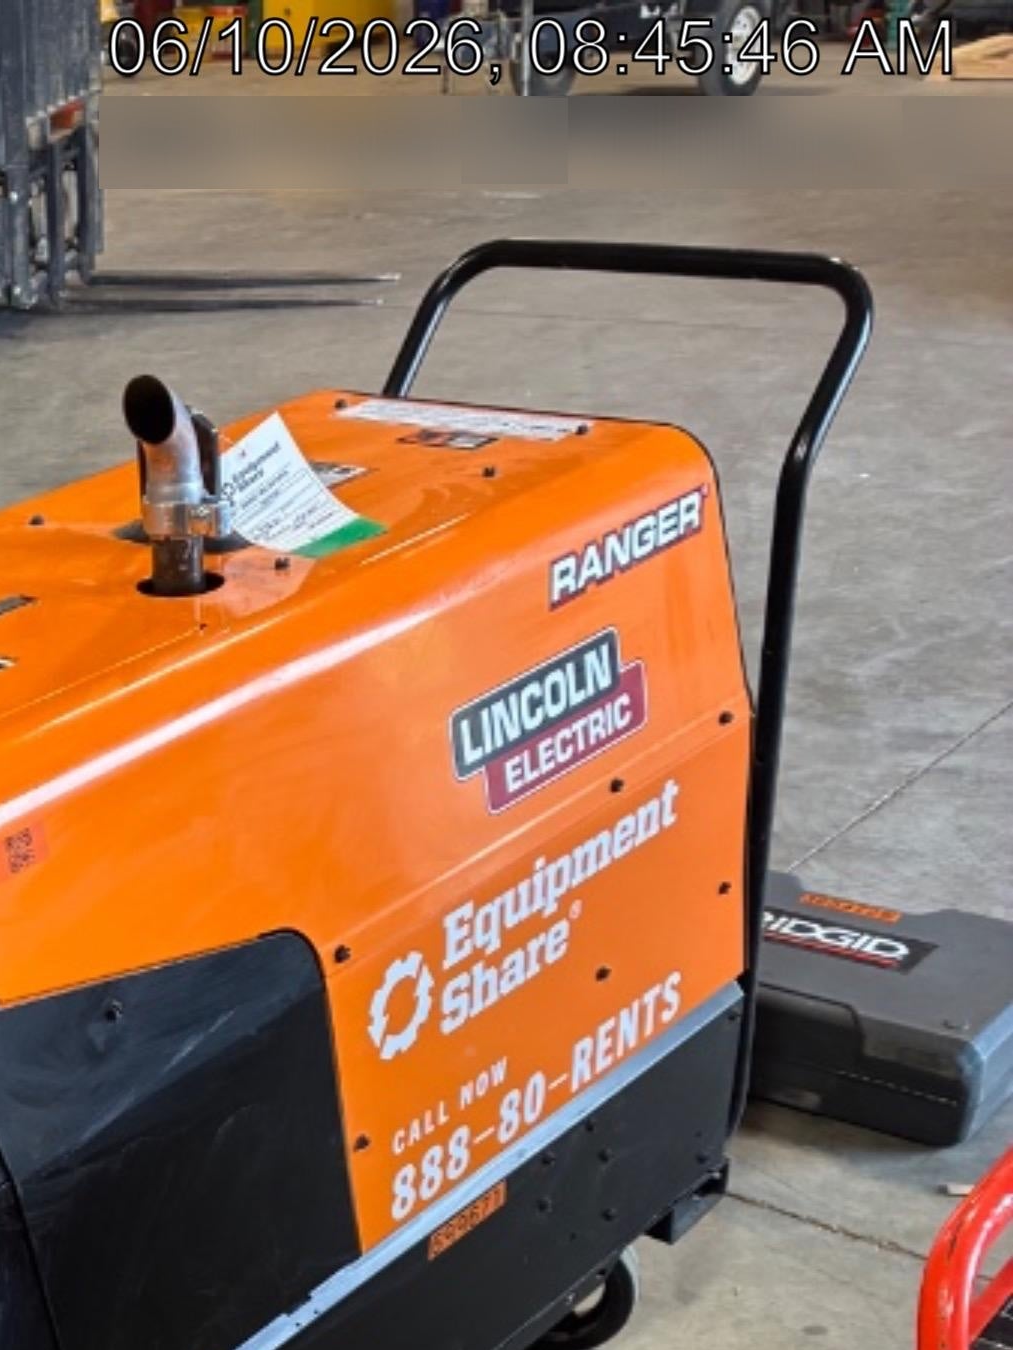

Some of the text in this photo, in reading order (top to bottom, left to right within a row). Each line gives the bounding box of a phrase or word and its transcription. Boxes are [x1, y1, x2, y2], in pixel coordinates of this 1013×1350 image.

[550, 490, 702, 603] RANGER
[458, 642, 614, 767] LINCOLN
[503, 693, 632, 794] ELECTRIC
[442, 778, 680, 970] Equipment
[763, 911, 910, 960] IDGID
[390, 970, 682, 1221] 888-80-RENTS
[392, 1056, 509, 1155] CALL NOW
